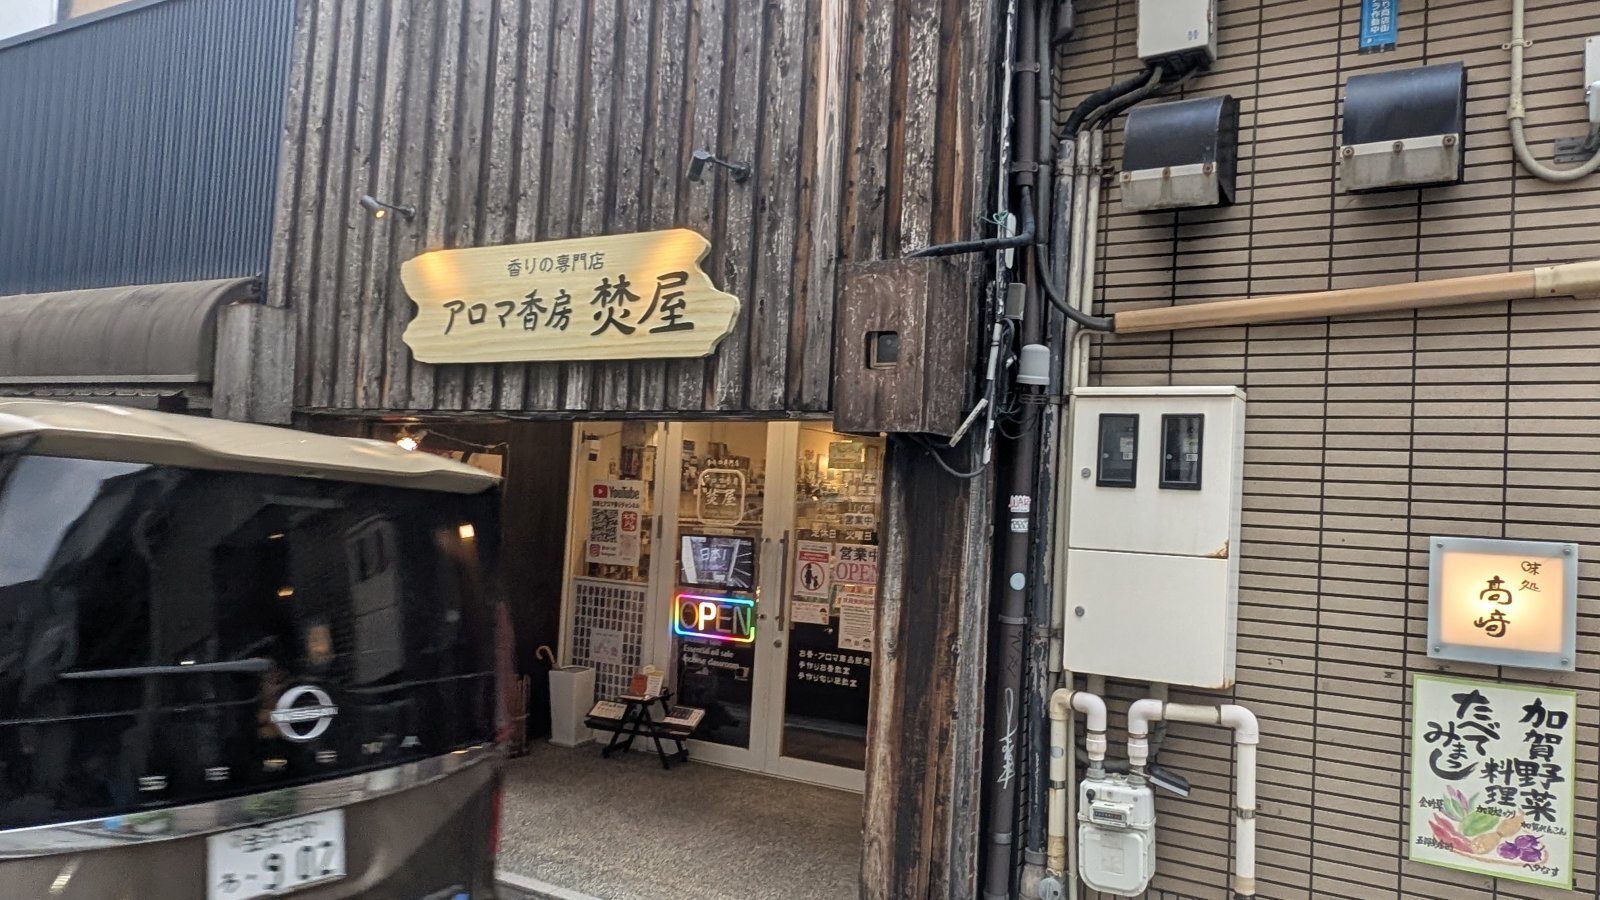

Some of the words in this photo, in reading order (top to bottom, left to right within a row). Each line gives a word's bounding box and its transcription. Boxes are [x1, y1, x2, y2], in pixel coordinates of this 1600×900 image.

[507, 252, 605, 277] 香りの専門店
[442, 288, 573, 335] アロマ香房
[590, 271, 694, 336] 焚屋
[608, 486, 640, 499] YouTube
[1518, 560, 1542, 593] 味処
[681, 601, 752, 636] OPEN
[1451, 689, 1501, 756] たべて
[1513, 697, 1569, 823] 加賀野菜
[1479, 757, 1519, 807] 料理
